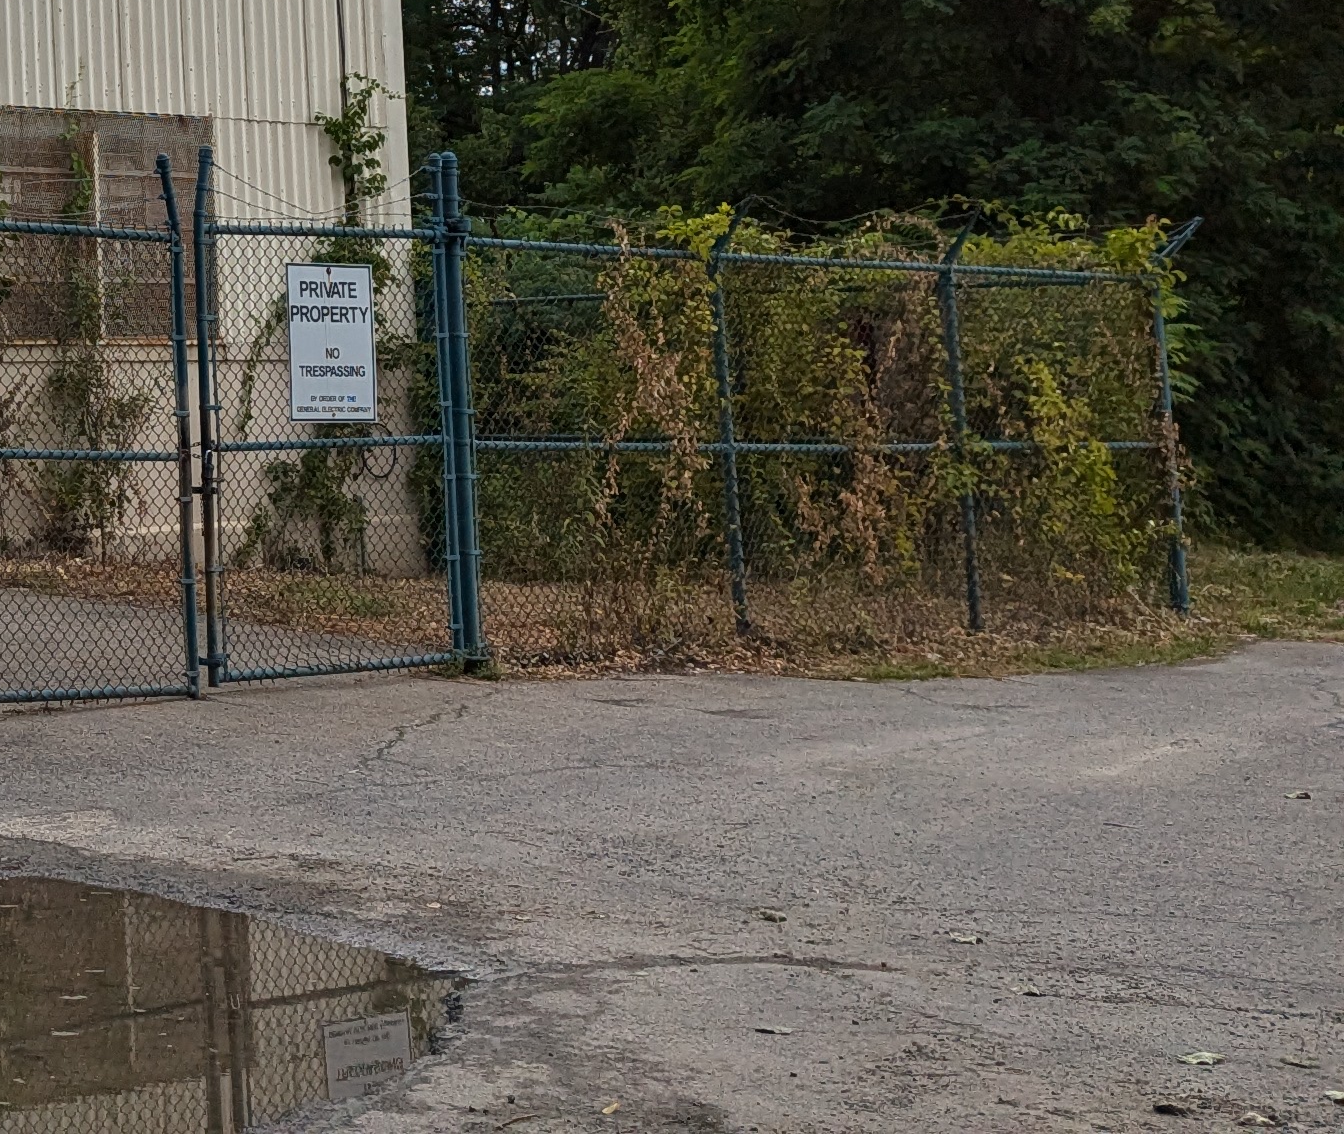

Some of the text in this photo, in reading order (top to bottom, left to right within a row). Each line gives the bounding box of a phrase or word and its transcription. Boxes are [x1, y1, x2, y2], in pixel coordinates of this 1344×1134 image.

[299, 280, 357, 299] PRIVATE
[290, 305, 369, 323] PROPERTY
[325, 347, 340, 360] NO
[299, 365, 366, 377] TRESPASSING
